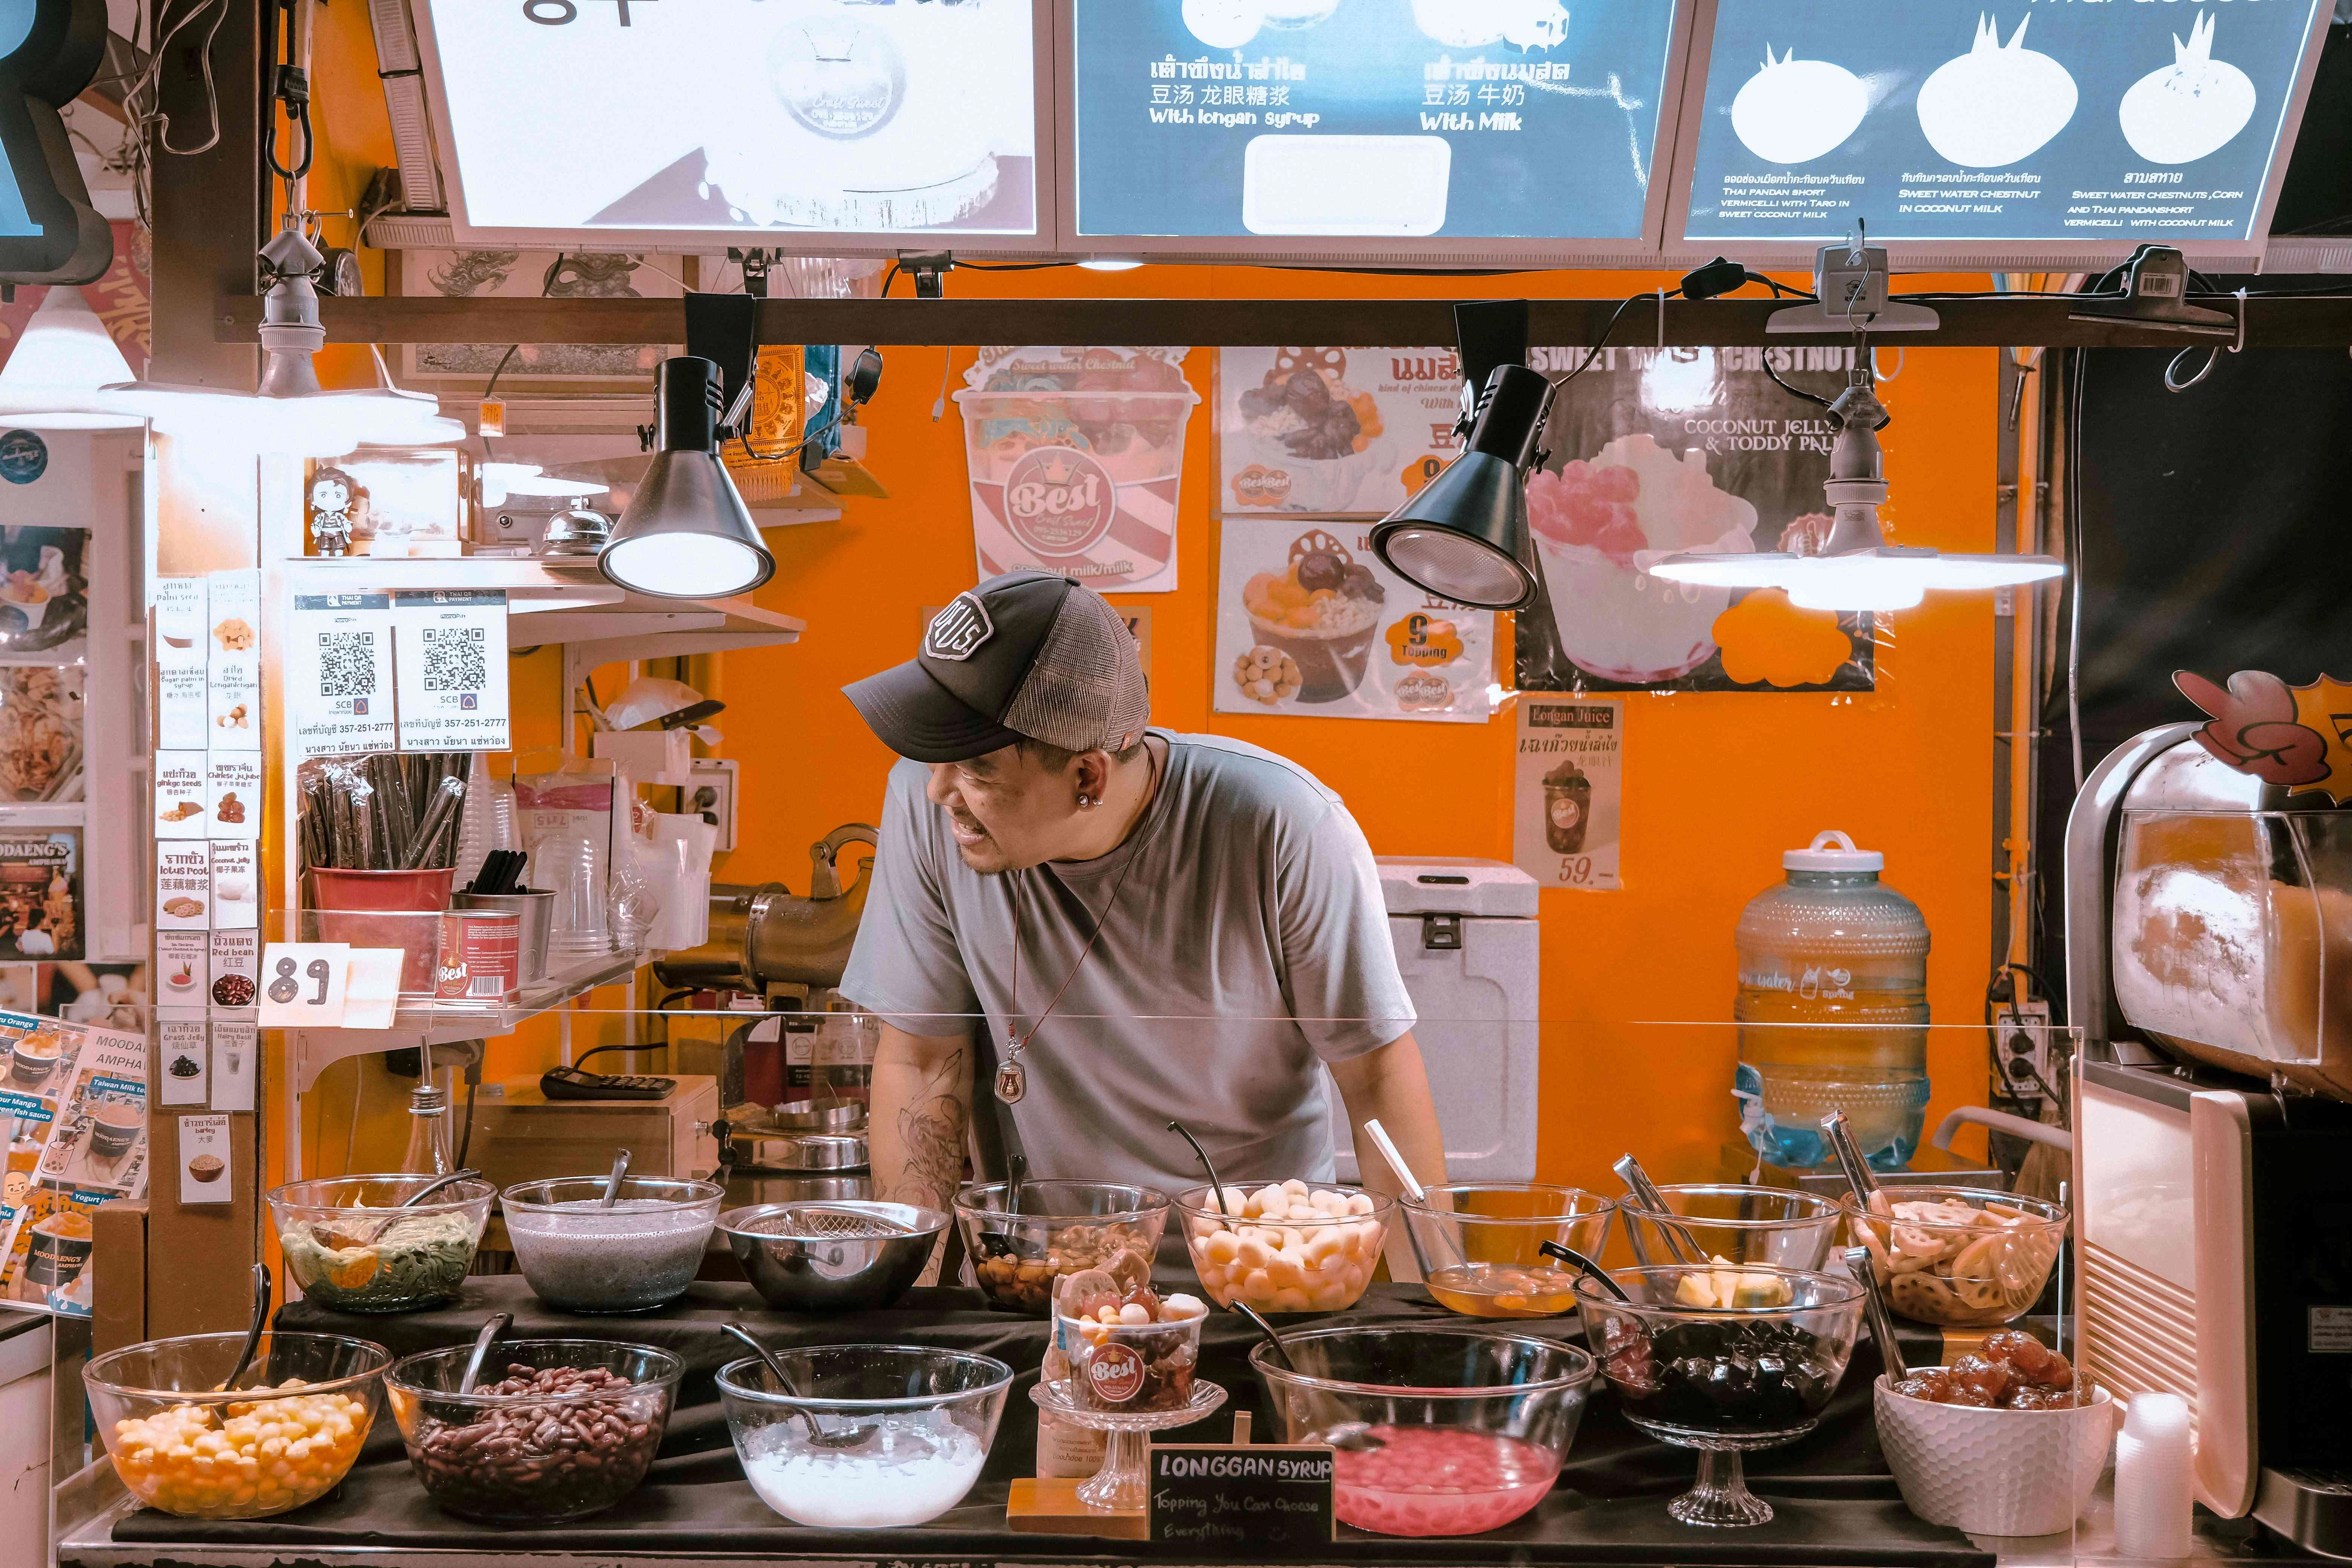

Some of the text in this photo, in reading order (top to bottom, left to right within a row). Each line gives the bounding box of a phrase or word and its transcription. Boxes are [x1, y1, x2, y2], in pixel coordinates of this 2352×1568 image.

[1150, 84, 1290, 106] 豆汤 龙眼糖浆
[1421, 84, 1525, 106] 豆汤 牛奶
[1149, 108, 1320, 129] With longan syrup
[1419, 112, 1522, 131] With Milk
[1899, 189, 1939, 198] SWEET
[2072, 190, 2110, 199] SWEET
[1531, 347, 1615, 371] SWEET
[1684, 419, 1834, 438] COCONUT JELLY
[1704, 436, 1793, 456] & TODDY
[1010, 474, 1101, 518] Best
[934, 600, 981, 651] DEUS
[1409, 615, 1427, 646] 9
[444, 719, 506, 728] 357-251-2777
[1532, 707, 1610, 725] Longan Juice
[340, 723, 394, 733] 357-251-2777
[306, 744, 335, 753] นางสาว
[407, 738, 440, 746] นางสาว
[165, 850, 205, 865] รากบัว
[160, 866, 209, 875] lotus root
[160, 878, 208, 890] 莲藕糖浆
[213, 931, 253, 946] ถั่วแดง
[223, 957, 244, 967] 红豆
[439, 962, 468, 982] Best
[267, 957, 330, 1006] 89
[7, 1017, 34, 1028] Orange
[96, 1054, 146, 1070] AMPHA
[94, 1079, 119, 1089] Taiwan
[120, 1084, 136, 1092] Milk
[12, 1097, 37, 1108] Mango
[75, 1193, 100, 1204] Yogurt
[34, 1249, 82, 1263] MOODAENG'S
[1091, 1356, 1137, 1381] Best
[1160, 1455, 1333, 1479] LONGGAN SYRUP
[1153, 1488, 1207, 1517] Topping
[1213, 1493, 1242, 1514] You
